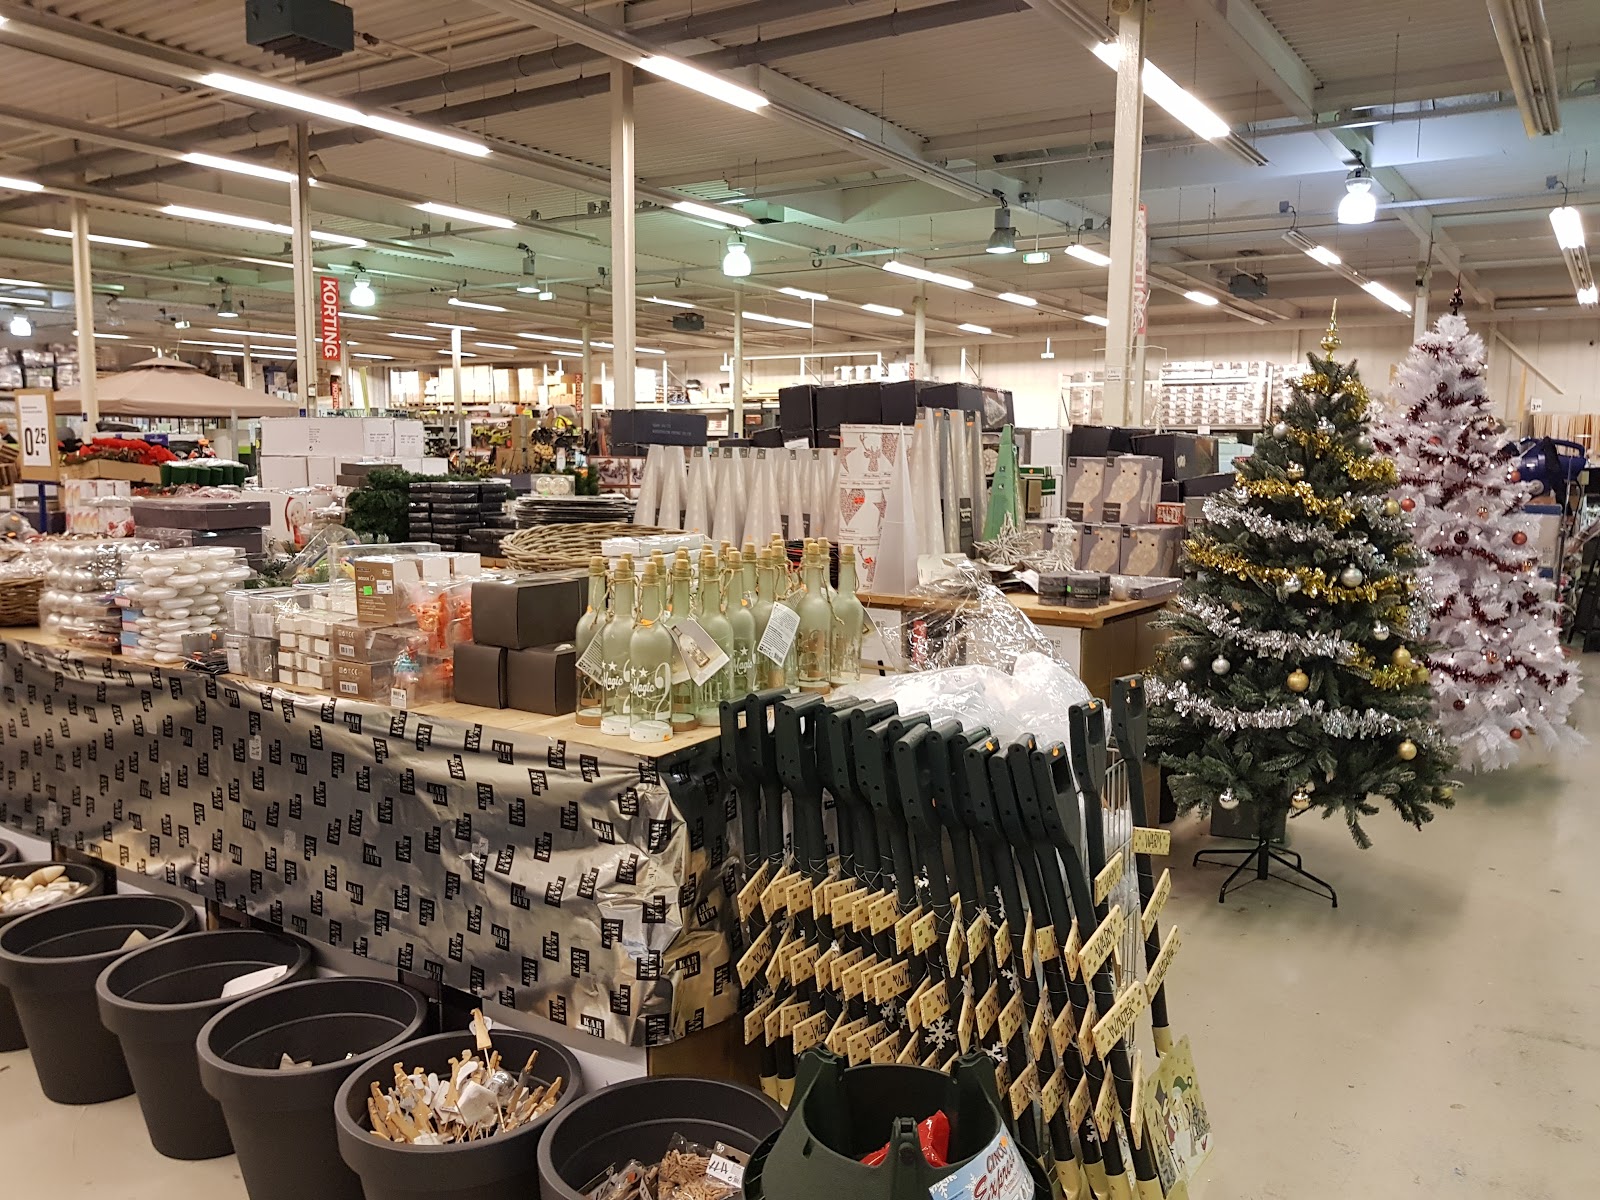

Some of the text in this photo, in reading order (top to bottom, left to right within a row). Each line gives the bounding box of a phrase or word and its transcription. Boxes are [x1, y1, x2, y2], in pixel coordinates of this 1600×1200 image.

[322, 279, 338, 358] KORTING
[331, 383, 340, 409] KORTIN
[601, 671, 624, 691] Magic
[630, 677, 655, 698] Magic
[391, 715, 399, 734] WEI
[396, 713, 405, 735] KAR
[466, 729, 474, 749] WEI
[471, 726, 479, 750] KAR
[494, 743, 510, 753] KAR
[449, 760, 458, 776] WEI
[453, 757, 463, 776] KAR
[581, 758, 591, 779] KAR
[587, 759, 596, 776] WEI
[428, 785, 444, 795] KAR
[530, 772, 540, 792] KAR
[536, 772, 545, 789] WEI
[478, 786, 486, 806] KAR
[620, 792, 630, 811] WEI
[626, 790, 637, 812] KAR
[594, 820, 611, 833] KAR
[597, 829, 612, 841] WEI
[650, 823, 659, 848] KAR
[536, 837, 544, 857] WEI
[541, 835, 550, 858] KAR
[477, 857, 485, 879] KAR
[497, 850, 506, 869] WEI
[502, 848, 512, 870] KAR
[625, 857, 635, 881] KAR
[619, 860, 628, 880] WEI
[546, 882, 556, 902] WEI
[552, 879, 563, 903] KAR
[579, 873, 590, 894] WEI
[585, 871, 596, 895] KAR
[493, 926, 507, 939] KAR
[495, 935, 507, 947] WEI
[603, 922, 611, 945] KAR
[611, 922, 619, 942] WEI
[1095, 923, 1114, 958] WARM
[640, 957, 648, 977] WEI
[648, 953, 656, 977] KAR
[678, 954, 697, 968] KAR
[682, 962, 697, 975] WEI
[583, 1017, 601, 1029] KAR
[1107, 1001, 1136, 1039] WINTER
[586, 1025, 602, 1036] WEI
